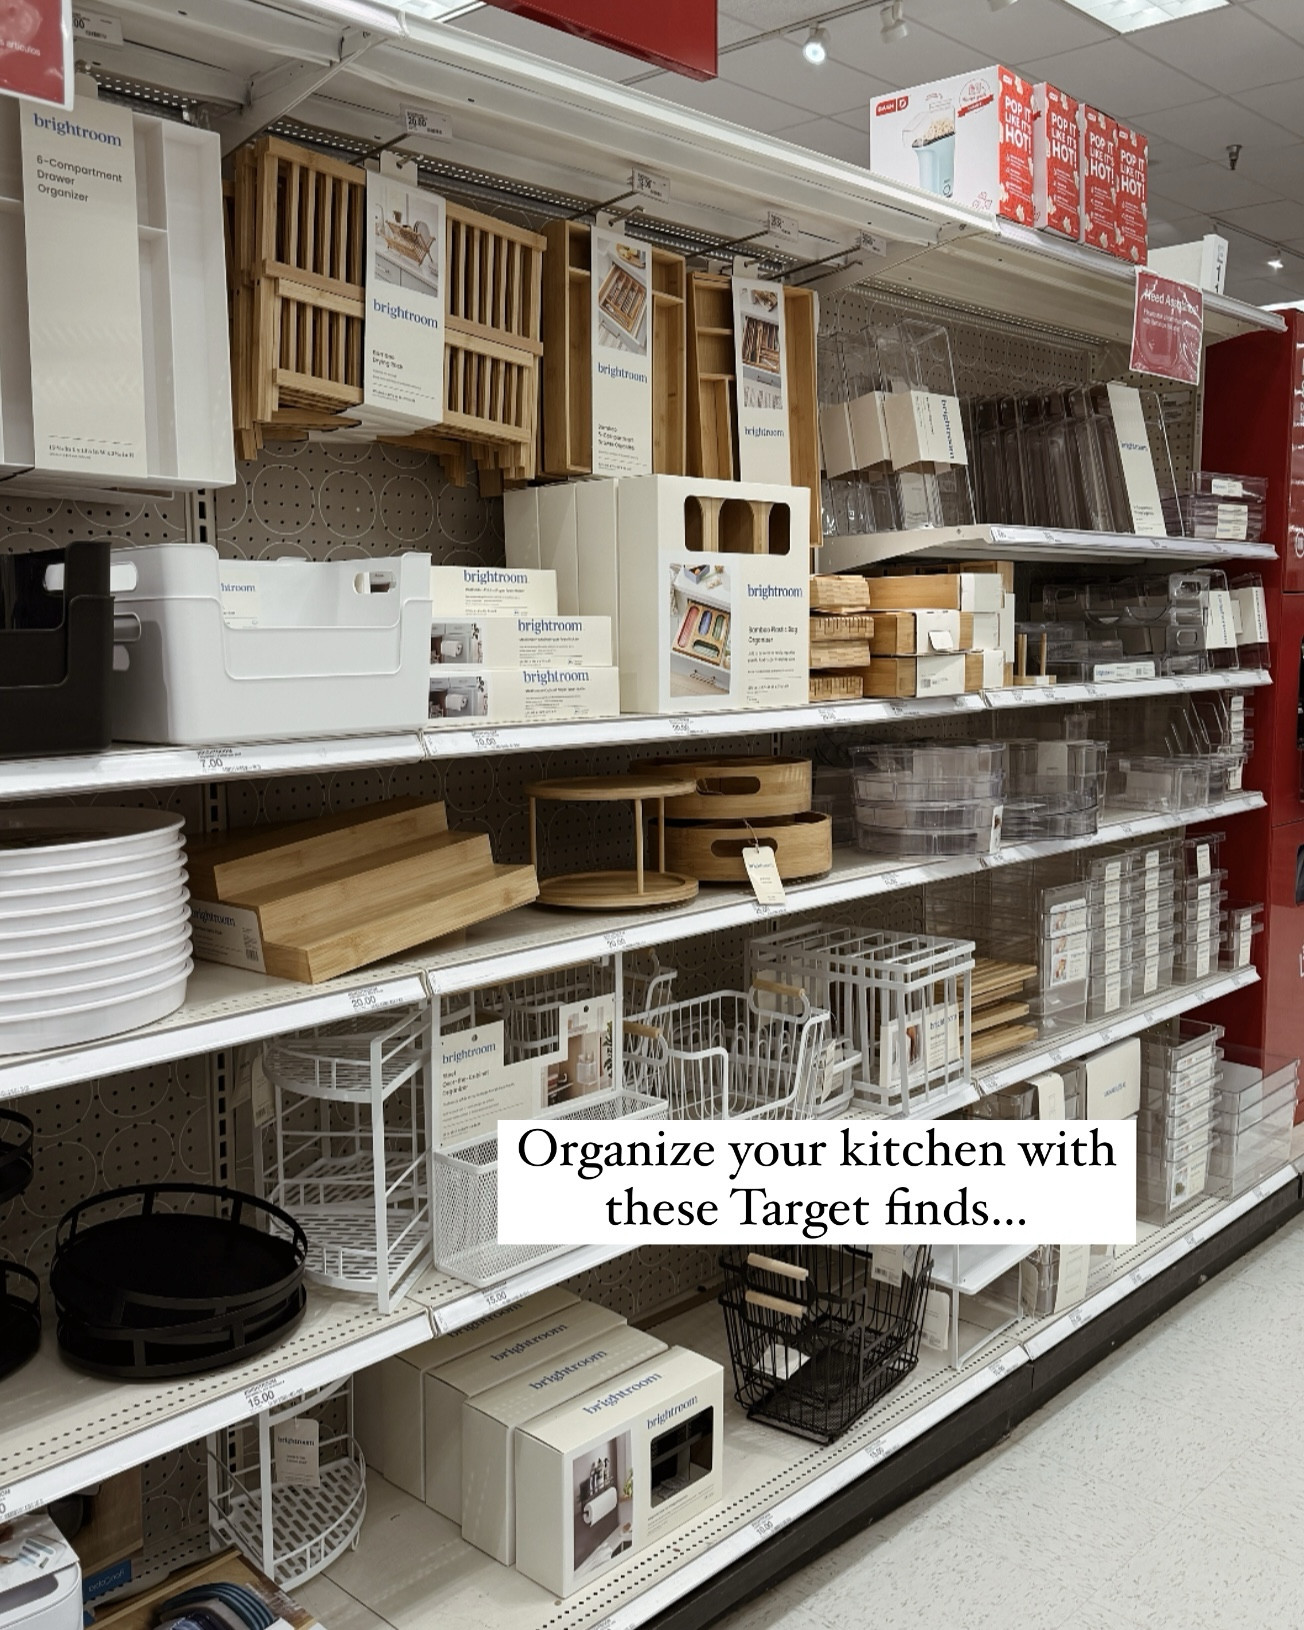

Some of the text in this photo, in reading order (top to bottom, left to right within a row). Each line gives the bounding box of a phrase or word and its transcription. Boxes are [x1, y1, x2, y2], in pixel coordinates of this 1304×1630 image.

[1004, 96, 1031, 121] POP IT
[1004, 111, 1020, 128] LIKE
[34, 112, 122, 147] brightroom
[1051, 111, 1076, 137] POP IT
[1004, 123, 1032, 154] HOT!
[1051, 128, 1066, 143] LIKE
[1089, 132, 1114, 157] POP IT
[1052, 140, 1077, 169] HOT!
[1089, 147, 1103, 162] LIKE
[1121, 149, 1145, 171] POP IT
[37, 154, 122, 182] 6-Compartment
[37, 169, 75, 185] Drawer
[1090, 158, 1114, 184] HOT!
[1120, 163, 1135, 178] LIKE
[38, 184, 88, 202] Organizer
[1121, 174, 1145, 201] HOT!
[373, 298, 438, 328] brightroom
[598, 362, 648, 383] brightroom
[463, 570, 528, 585] brightroom
[747, 584, 803, 600] brightroom
[518, 619, 582, 635] brightroom
[522, 670, 589, 686] brightroom
[199, 758, 224, 768] 7.00
[351, 995, 377, 1009] 20.00
[442, 1042, 496, 1065] brightroom
[490, 1322, 568, 1362] brightroom
[529, 1350, 608, 1390] brightroom
[247, 1390, 275, 1408] 15.00
[582, 1372, 663, 1415] brightroom
[646, 1395, 699, 1431] brightroom
